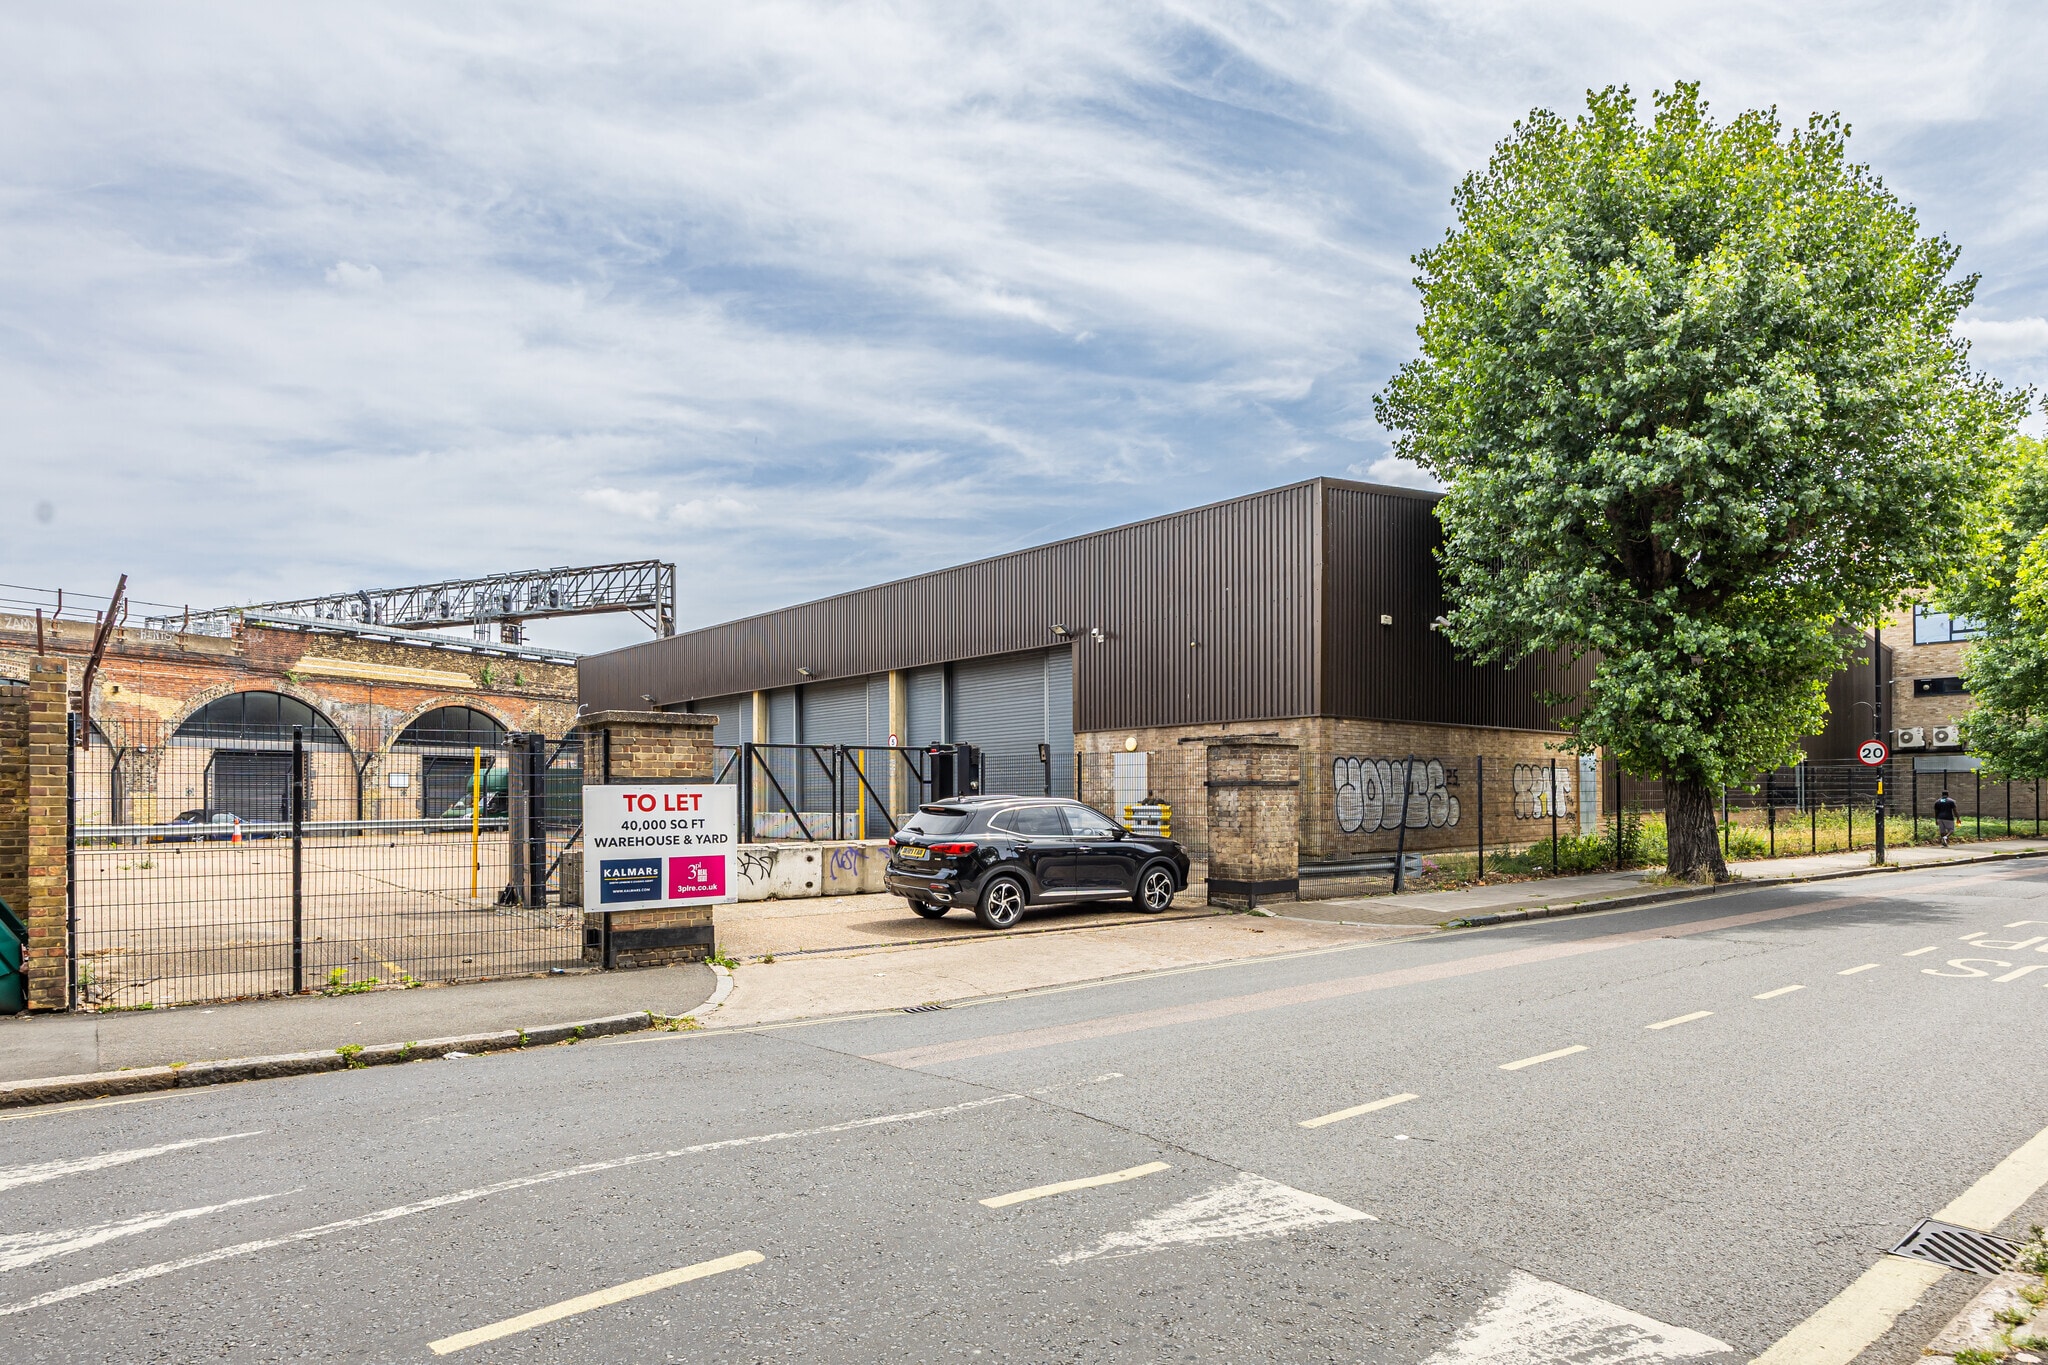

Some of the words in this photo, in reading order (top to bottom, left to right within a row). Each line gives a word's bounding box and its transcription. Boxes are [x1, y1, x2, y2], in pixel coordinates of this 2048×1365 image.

[1862, 748, 1883, 759] 20
[623, 794, 656, 812] TO
[664, 793, 702, 812] LET
[621, 820, 667, 832] 40,000
[670, 819, 688, 830] SQ
[691, 819, 705, 829] FT
[594, 835, 680, 848] WAREHOUSE
[683, 834, 693, 845] &
[695, 834, 728, 844] YARD
